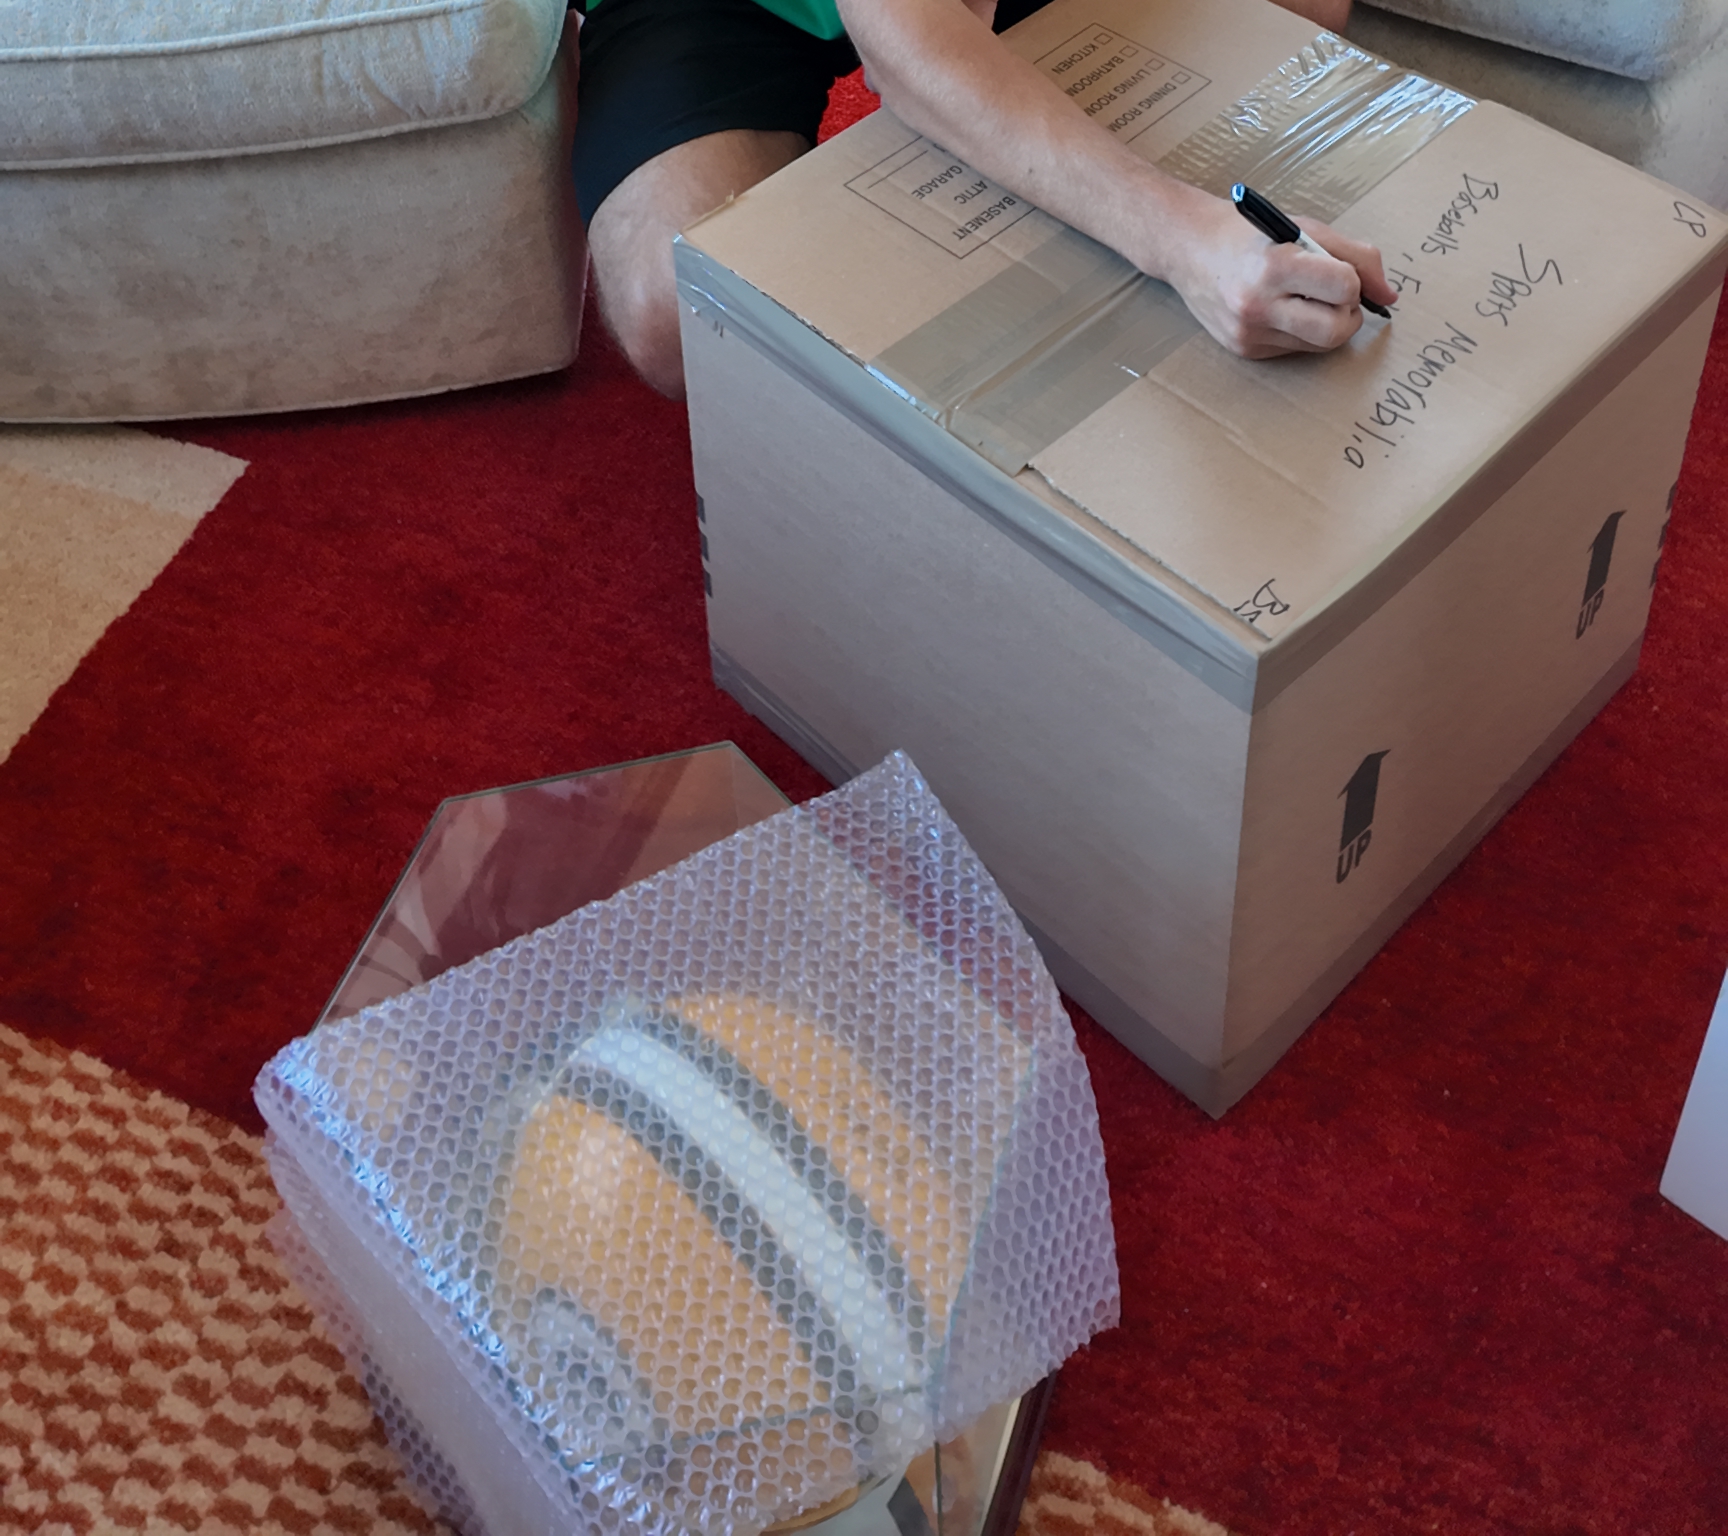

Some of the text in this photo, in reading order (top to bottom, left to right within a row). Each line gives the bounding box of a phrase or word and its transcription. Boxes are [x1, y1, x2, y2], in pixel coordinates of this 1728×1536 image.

[1051, 42, 1099, 76] KITCHEN
[1064, 55, 1125, 98] BATHROOM
[1083, 68, 1152, 118] LIVING ROOM
[1106, 81, 1178, 134] DINING ROOM
[911, 164, 963, 200] GARAGE
[953, 179, 989, 205] ATTIC
[952, 195, 1017, 241] BASEMENT
[1575, 587, 1605, 640] UP
[1336, 828, 1373, 885] UP
